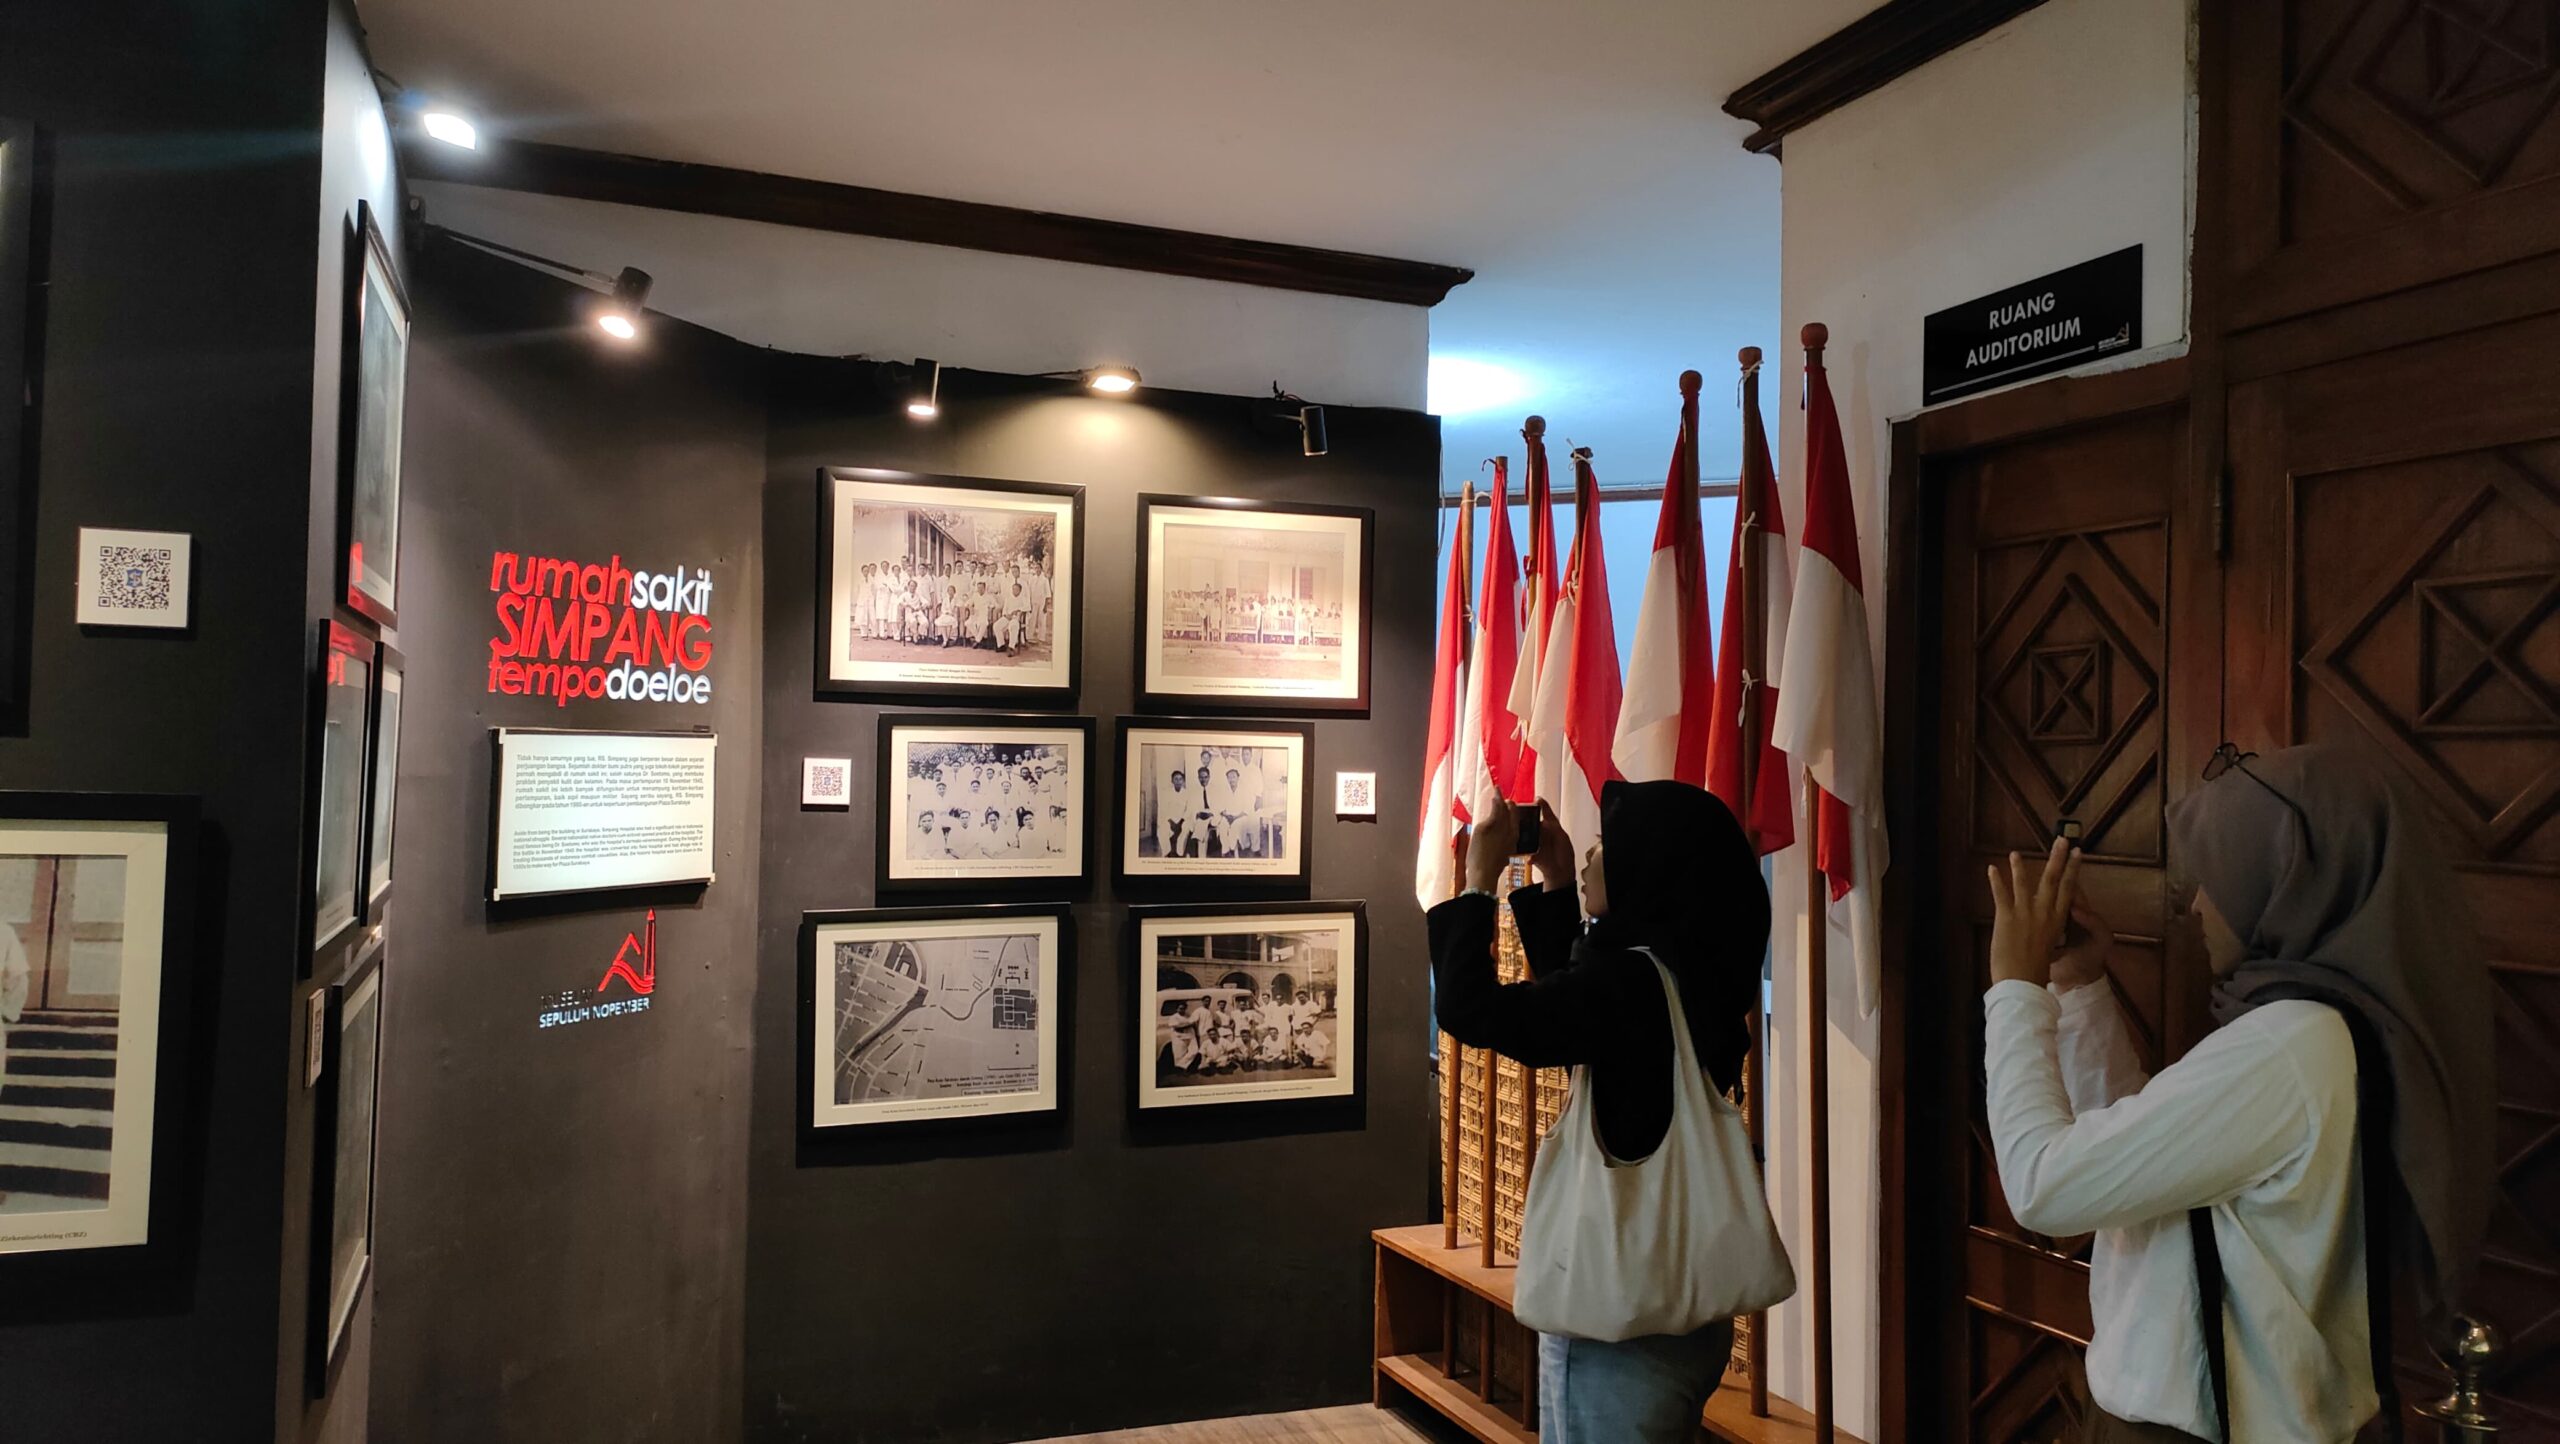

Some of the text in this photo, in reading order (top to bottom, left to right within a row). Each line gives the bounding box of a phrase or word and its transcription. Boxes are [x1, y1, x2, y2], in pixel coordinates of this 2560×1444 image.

[1989, 292, 2056, 330] RUANG
[1965, 317, 2081, 369] AUDITORIUM
[490, 592, 713, 672] SIMPANG
[540, 1007, 590, 1028] SEPULUH
